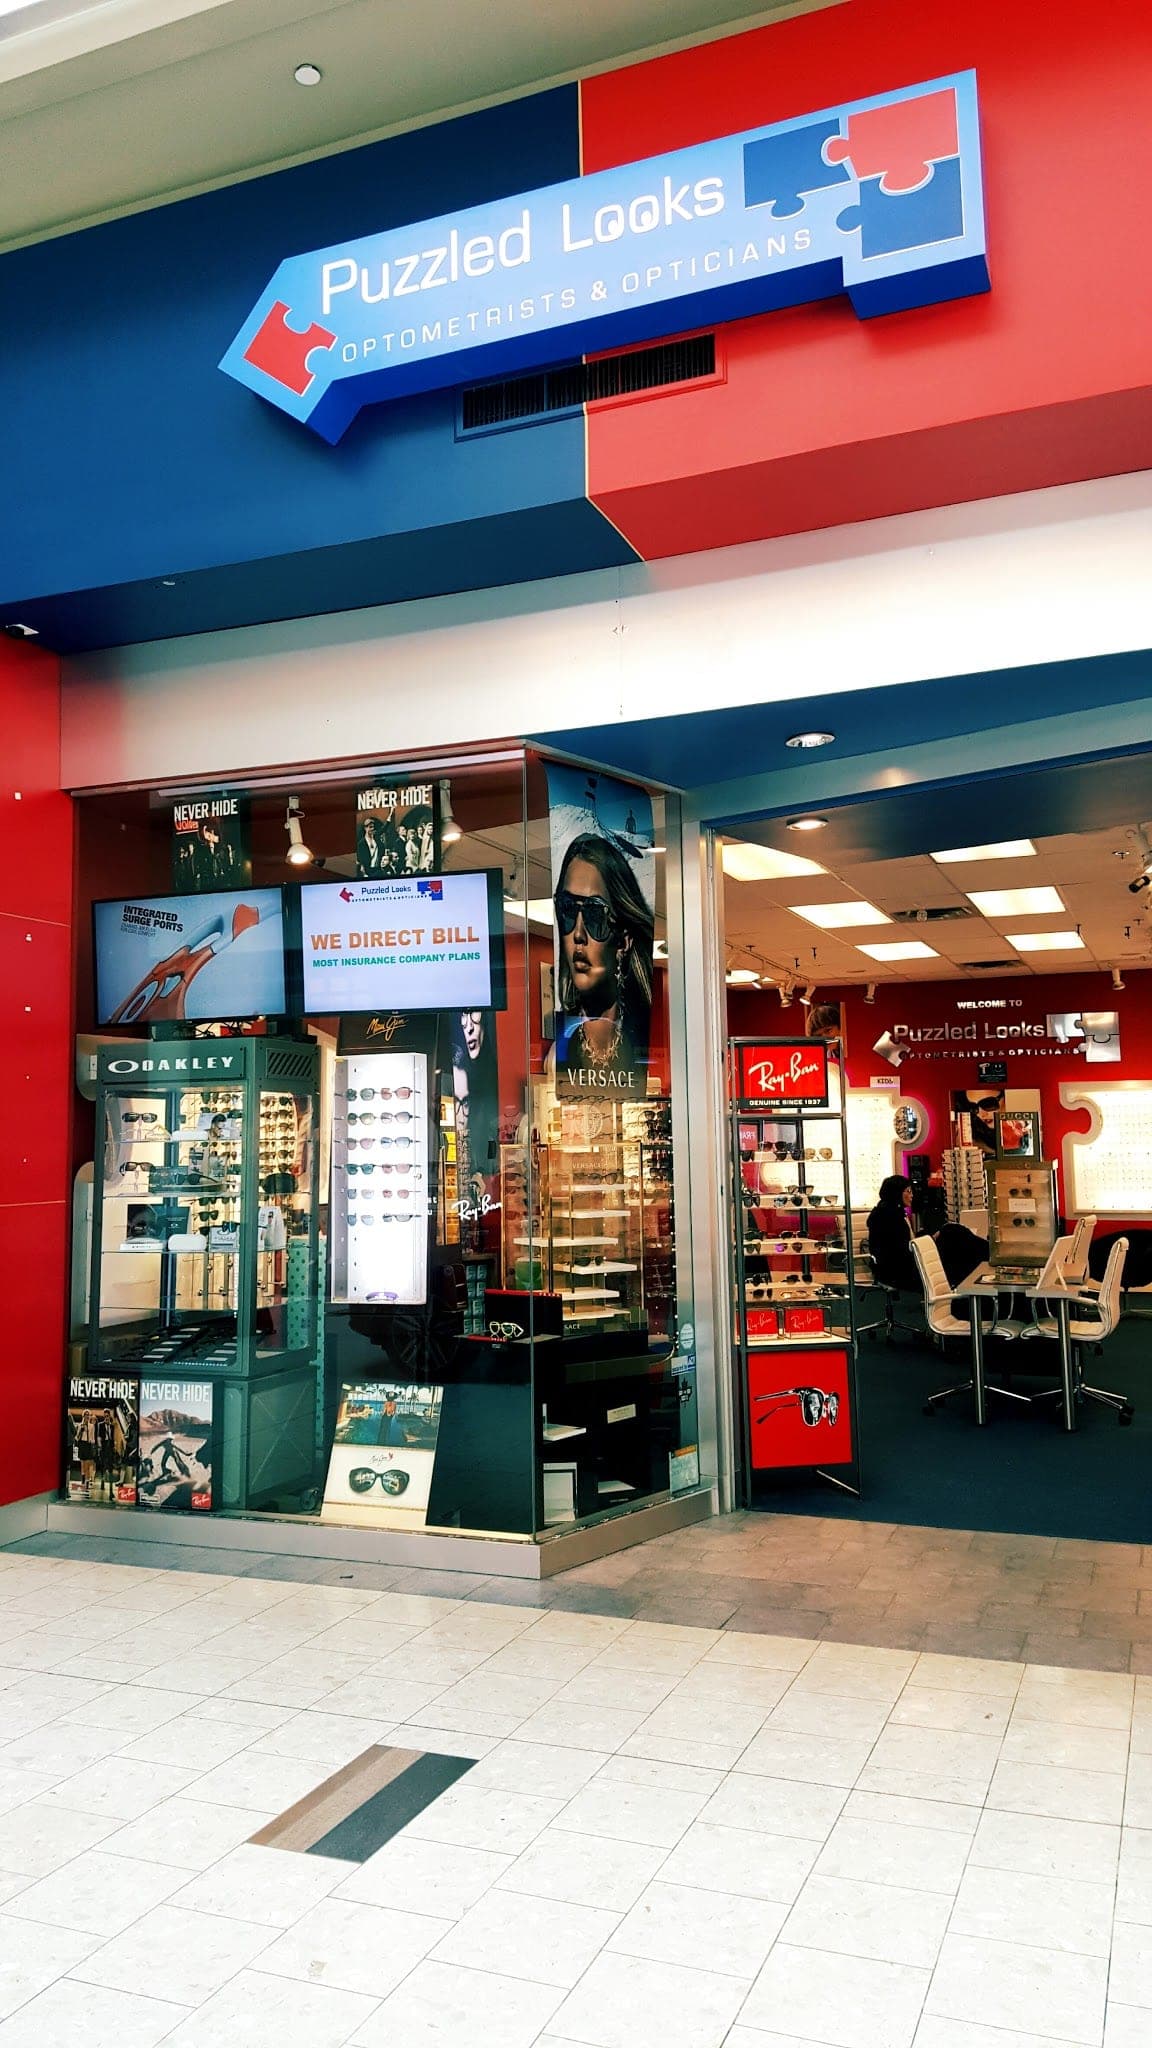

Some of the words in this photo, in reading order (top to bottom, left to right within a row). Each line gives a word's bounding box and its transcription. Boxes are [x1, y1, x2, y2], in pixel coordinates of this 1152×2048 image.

[322, 209, 531, 315] Puzzled
[562, 176, 725, 252] Looks
[342, 288, 576, 363] OPTOMETRISTS
[591, 280, 608, 301] &
[622, 228, 811, 293] OPTICIANS
[357, 789, 398, 810] NEVER
[400, 786, 431, 806] HIDE
[174, 803, 209, 822] NEVER
[211, 799, 239, 817] HIDE
[361, 885, 390, 895] Puzzled
[391, 885, 412, 893] Looks
[122, 914, 152, 927] SURGE
[153, 920, 184, 932] PORTS
[123, 905, 178, 922] INTEGRATED
[311, 933, 342, 950] WE
[349, 929, 425, 948] DIRECT
[433, 926, 480, 945] BILL
[313, 958, 339, 968] MOST
[341, 956, 396, 966] INSURANCE
[399, 953, 446, 964] COMPANY
[448, 952, 481, 961] PLANS
[957, 1000, 1007, 1009] WELCOME
[1008, 999, 1023, 1007] TO
[893, 1021, 977, 1042] Puzzled
[984, 1020, 1046, 1040] Looks
[1008, 1048, 1080, 1056] OPTICIANS
[141, 1056, 234, 1072] OAKLEY
[747, 1051, 820, 1092] Ray-Ban
[567, 1067, 636, 1088] VERSACE
[451, 1193, 503, 1221] Ray-Ban
[70, 1379, 106, 1398] NEVER
[109, 1380, 136, 1400] HIDE
[141, 1381, 180, 1401] NEVER
[182, 1383, 211, 1402] HIDE
